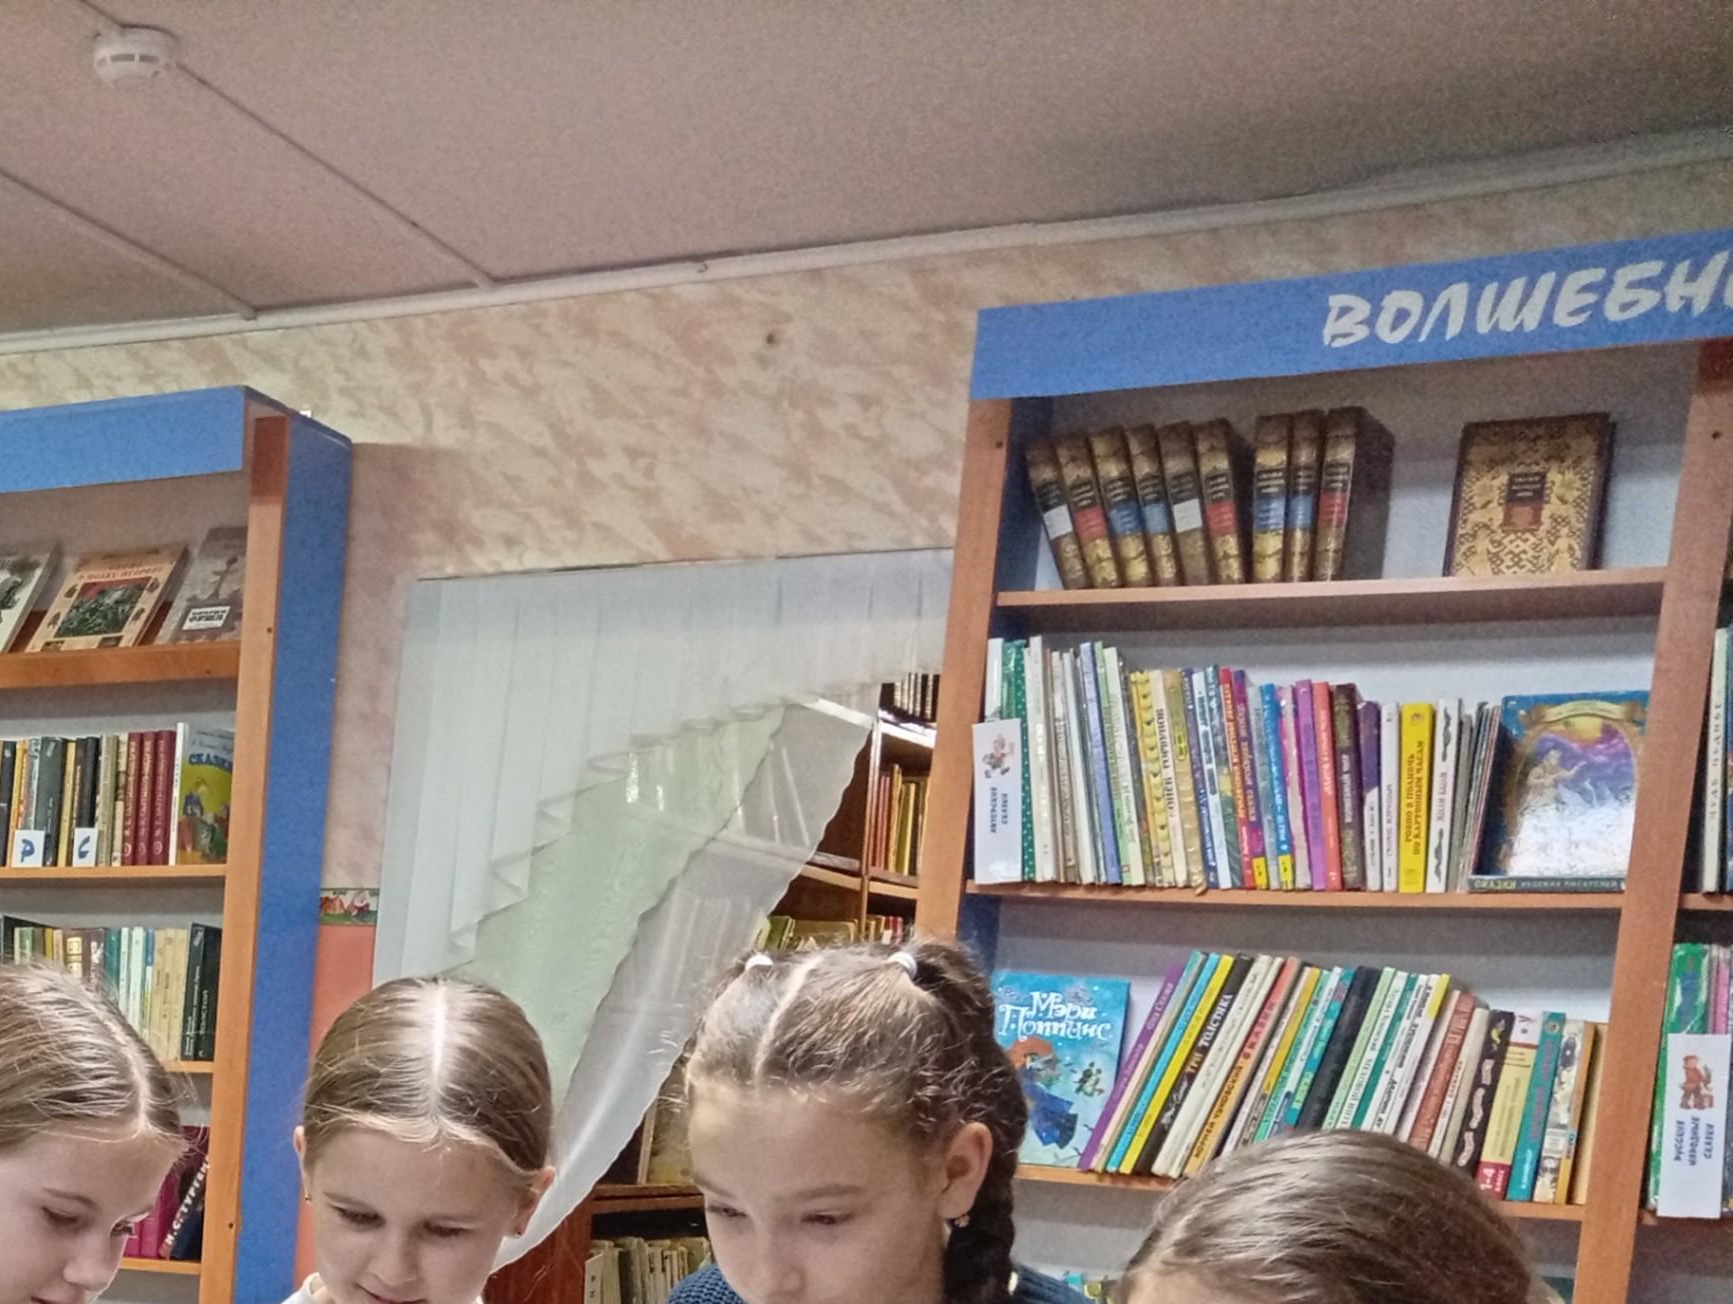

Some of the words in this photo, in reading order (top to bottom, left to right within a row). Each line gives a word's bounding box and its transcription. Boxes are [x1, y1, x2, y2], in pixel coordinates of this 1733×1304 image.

[1323, 250, 1733, 348] ВОЛШЕБН
[1416, 739, 1424, 773] ЧАСАМ
[1405, 753, 1414, 799] ПОЛНОЧЬ
[1000, 792, 1009, 824] СКАЗКИ
[1404, 810, 1412, 842] РОВНО
[1413, 776, 1422, 838] КАРТОННЫМ
[1413, 840, 1420, 854] ПО
[1474, 880, 1517, 890] СКАЗКИ
[199, 990, 208, 1034] ТОЛСТОЙ
[998, 1004, 1112, 1042] Поппинс
[1028, 992, 1098, 1020] Мэри
[1185, 1050, 1203, 1075] ТРИ
[1198, 990, 1233, 1050] ТОЛСТЯКА
[1193, 1120, 1217, 1159] КОРНЕЙ
[1210, 1063, 1244, 1121] ЧУКОВСКИЙ
[1673, 1120, 1686, 1161] РУССКИЕ
[1687, 1115, 1701, 1166] НАРОДНЫЕ
[1702, 1123, 1715, 1159] СКАЗКИ
[1479, 1166, 1497, 1191] 1-4
